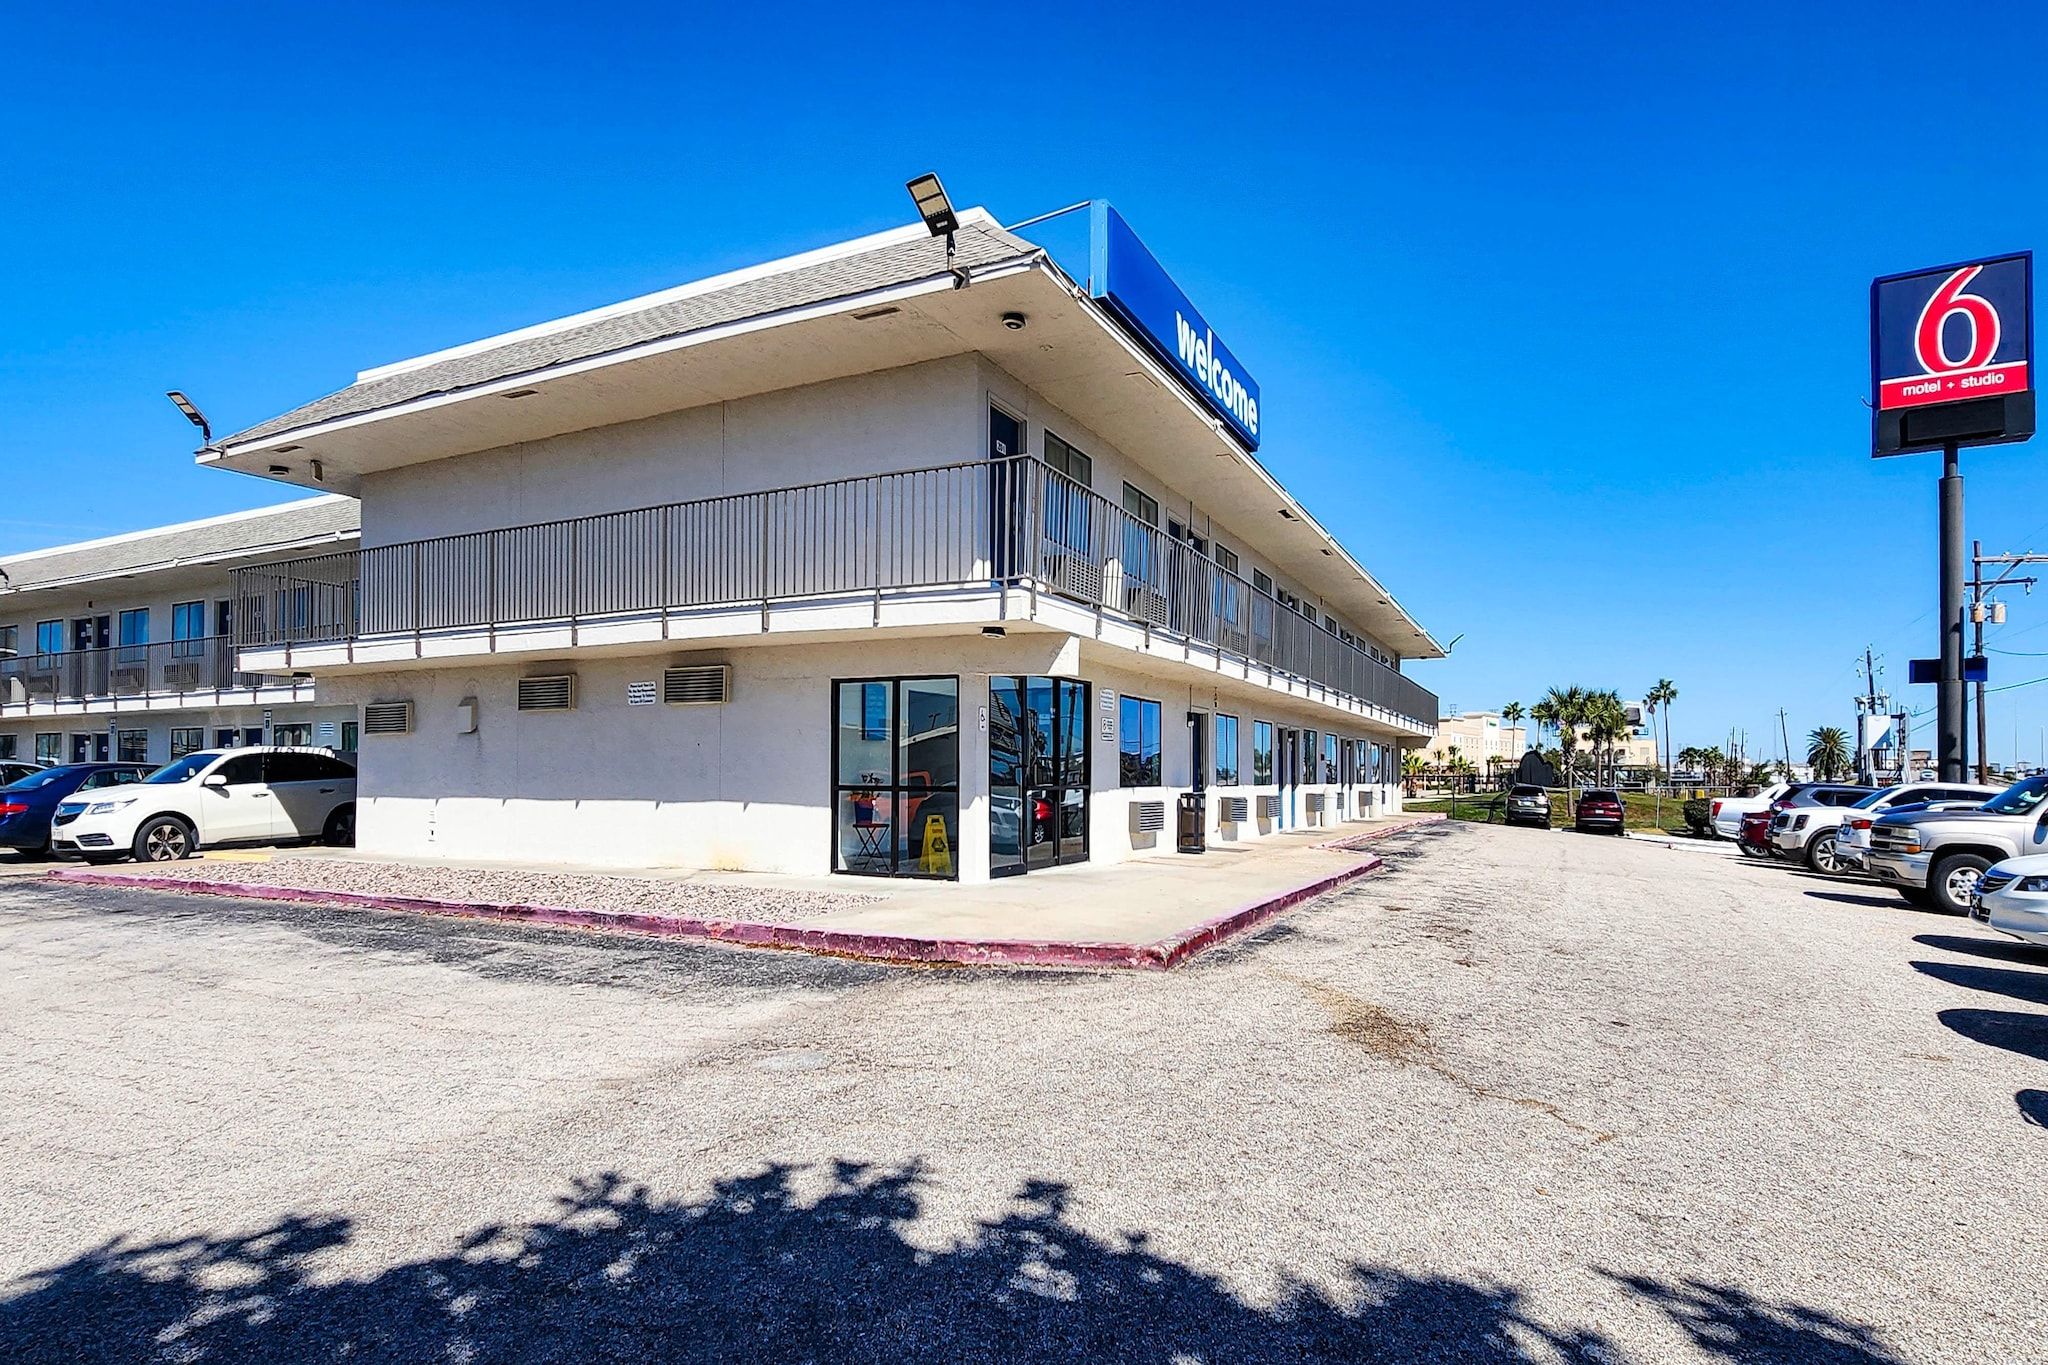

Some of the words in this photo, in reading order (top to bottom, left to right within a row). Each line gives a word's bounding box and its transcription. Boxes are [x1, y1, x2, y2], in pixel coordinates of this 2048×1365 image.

[1175, 310, 1258, 436] welcome
[1914, 264, 2001, 375] 6
[1902, 380, 1941, 397] motel
[1960, 371, 2005, 389] studio
